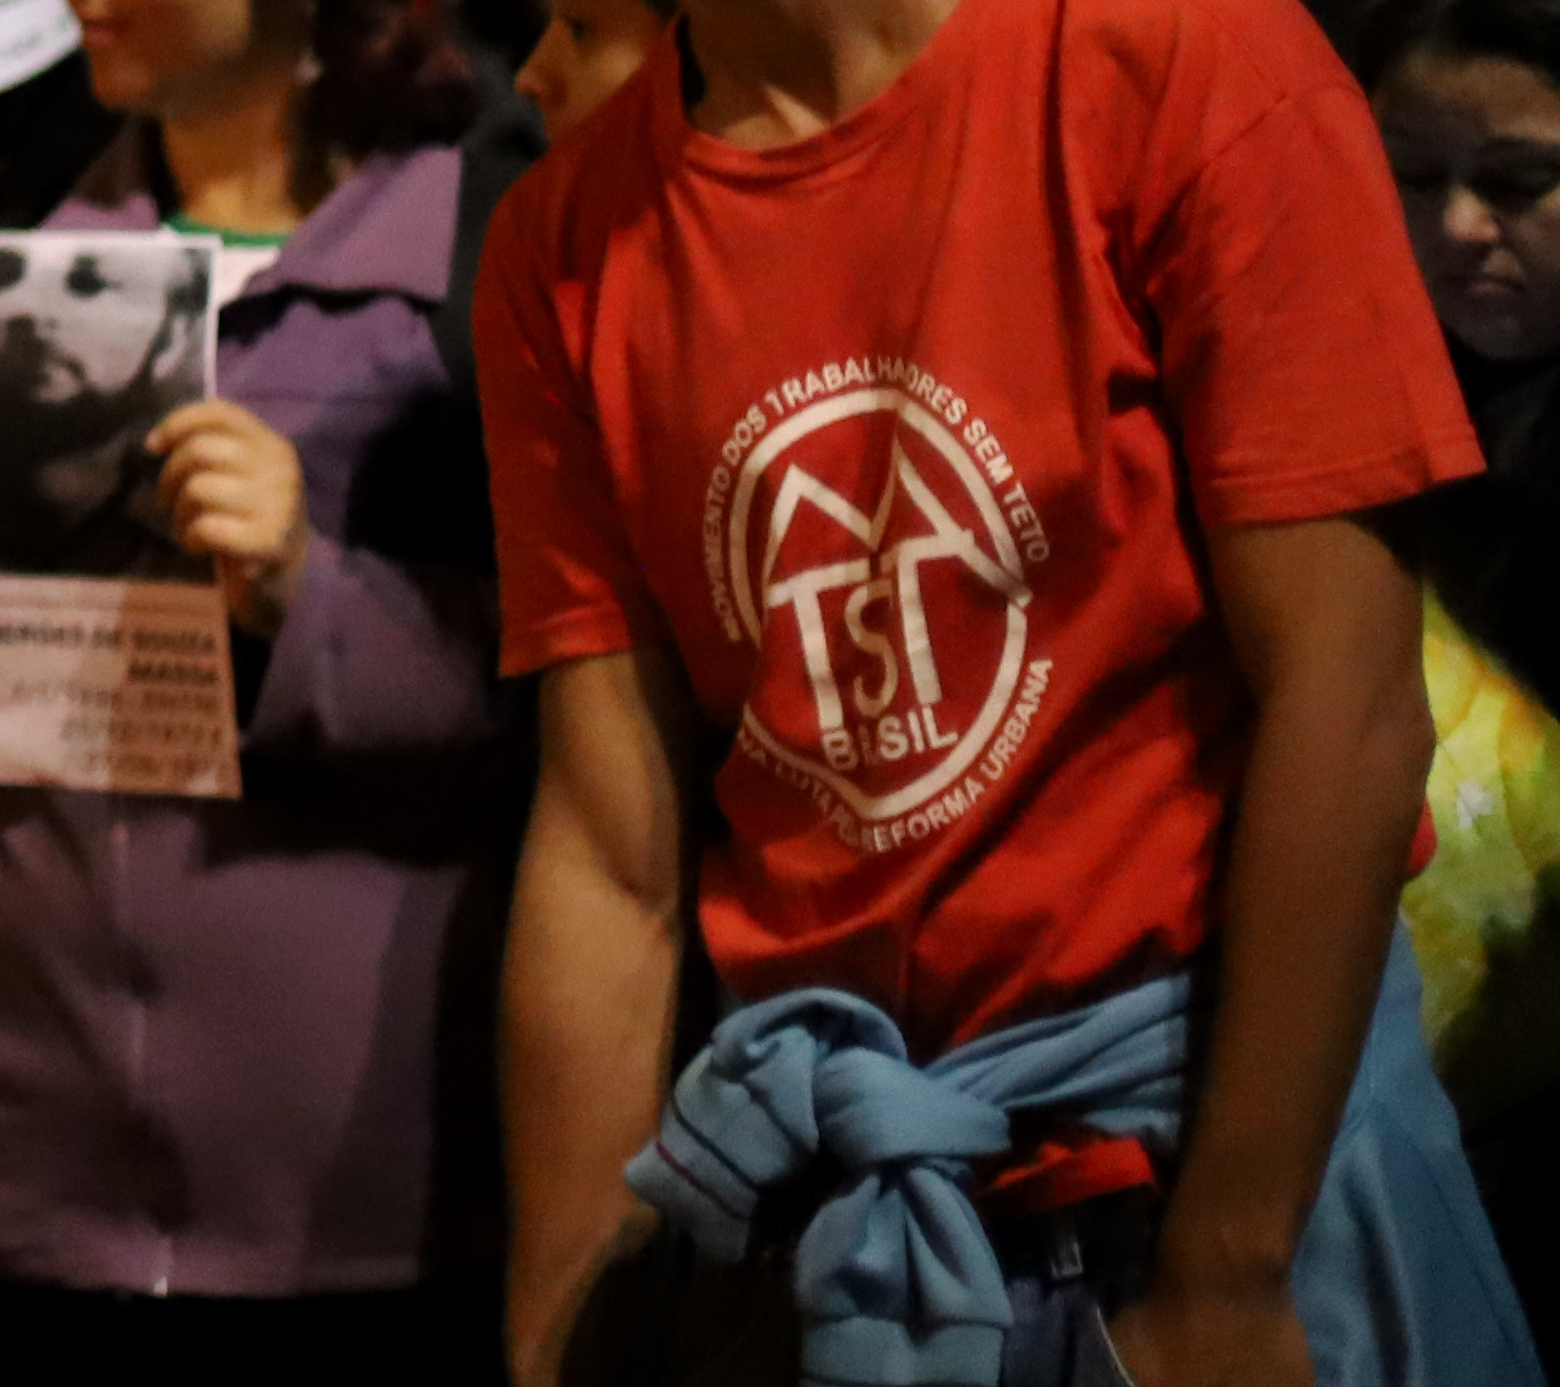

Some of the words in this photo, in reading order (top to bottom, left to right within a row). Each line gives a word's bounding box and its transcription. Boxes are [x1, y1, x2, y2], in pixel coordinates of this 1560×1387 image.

[722, 404, 767, 466] DOS
[765, 355, 968, 426] TRABALHAORES
[963, 418, 1015, 484] SEM
[1004, 480, 1051, 563] TETO
[823, 706, 959, 771] BSIL
[861, 776, 985, 853] EFORMA
[980, 657, 1054, 782] URBANA
